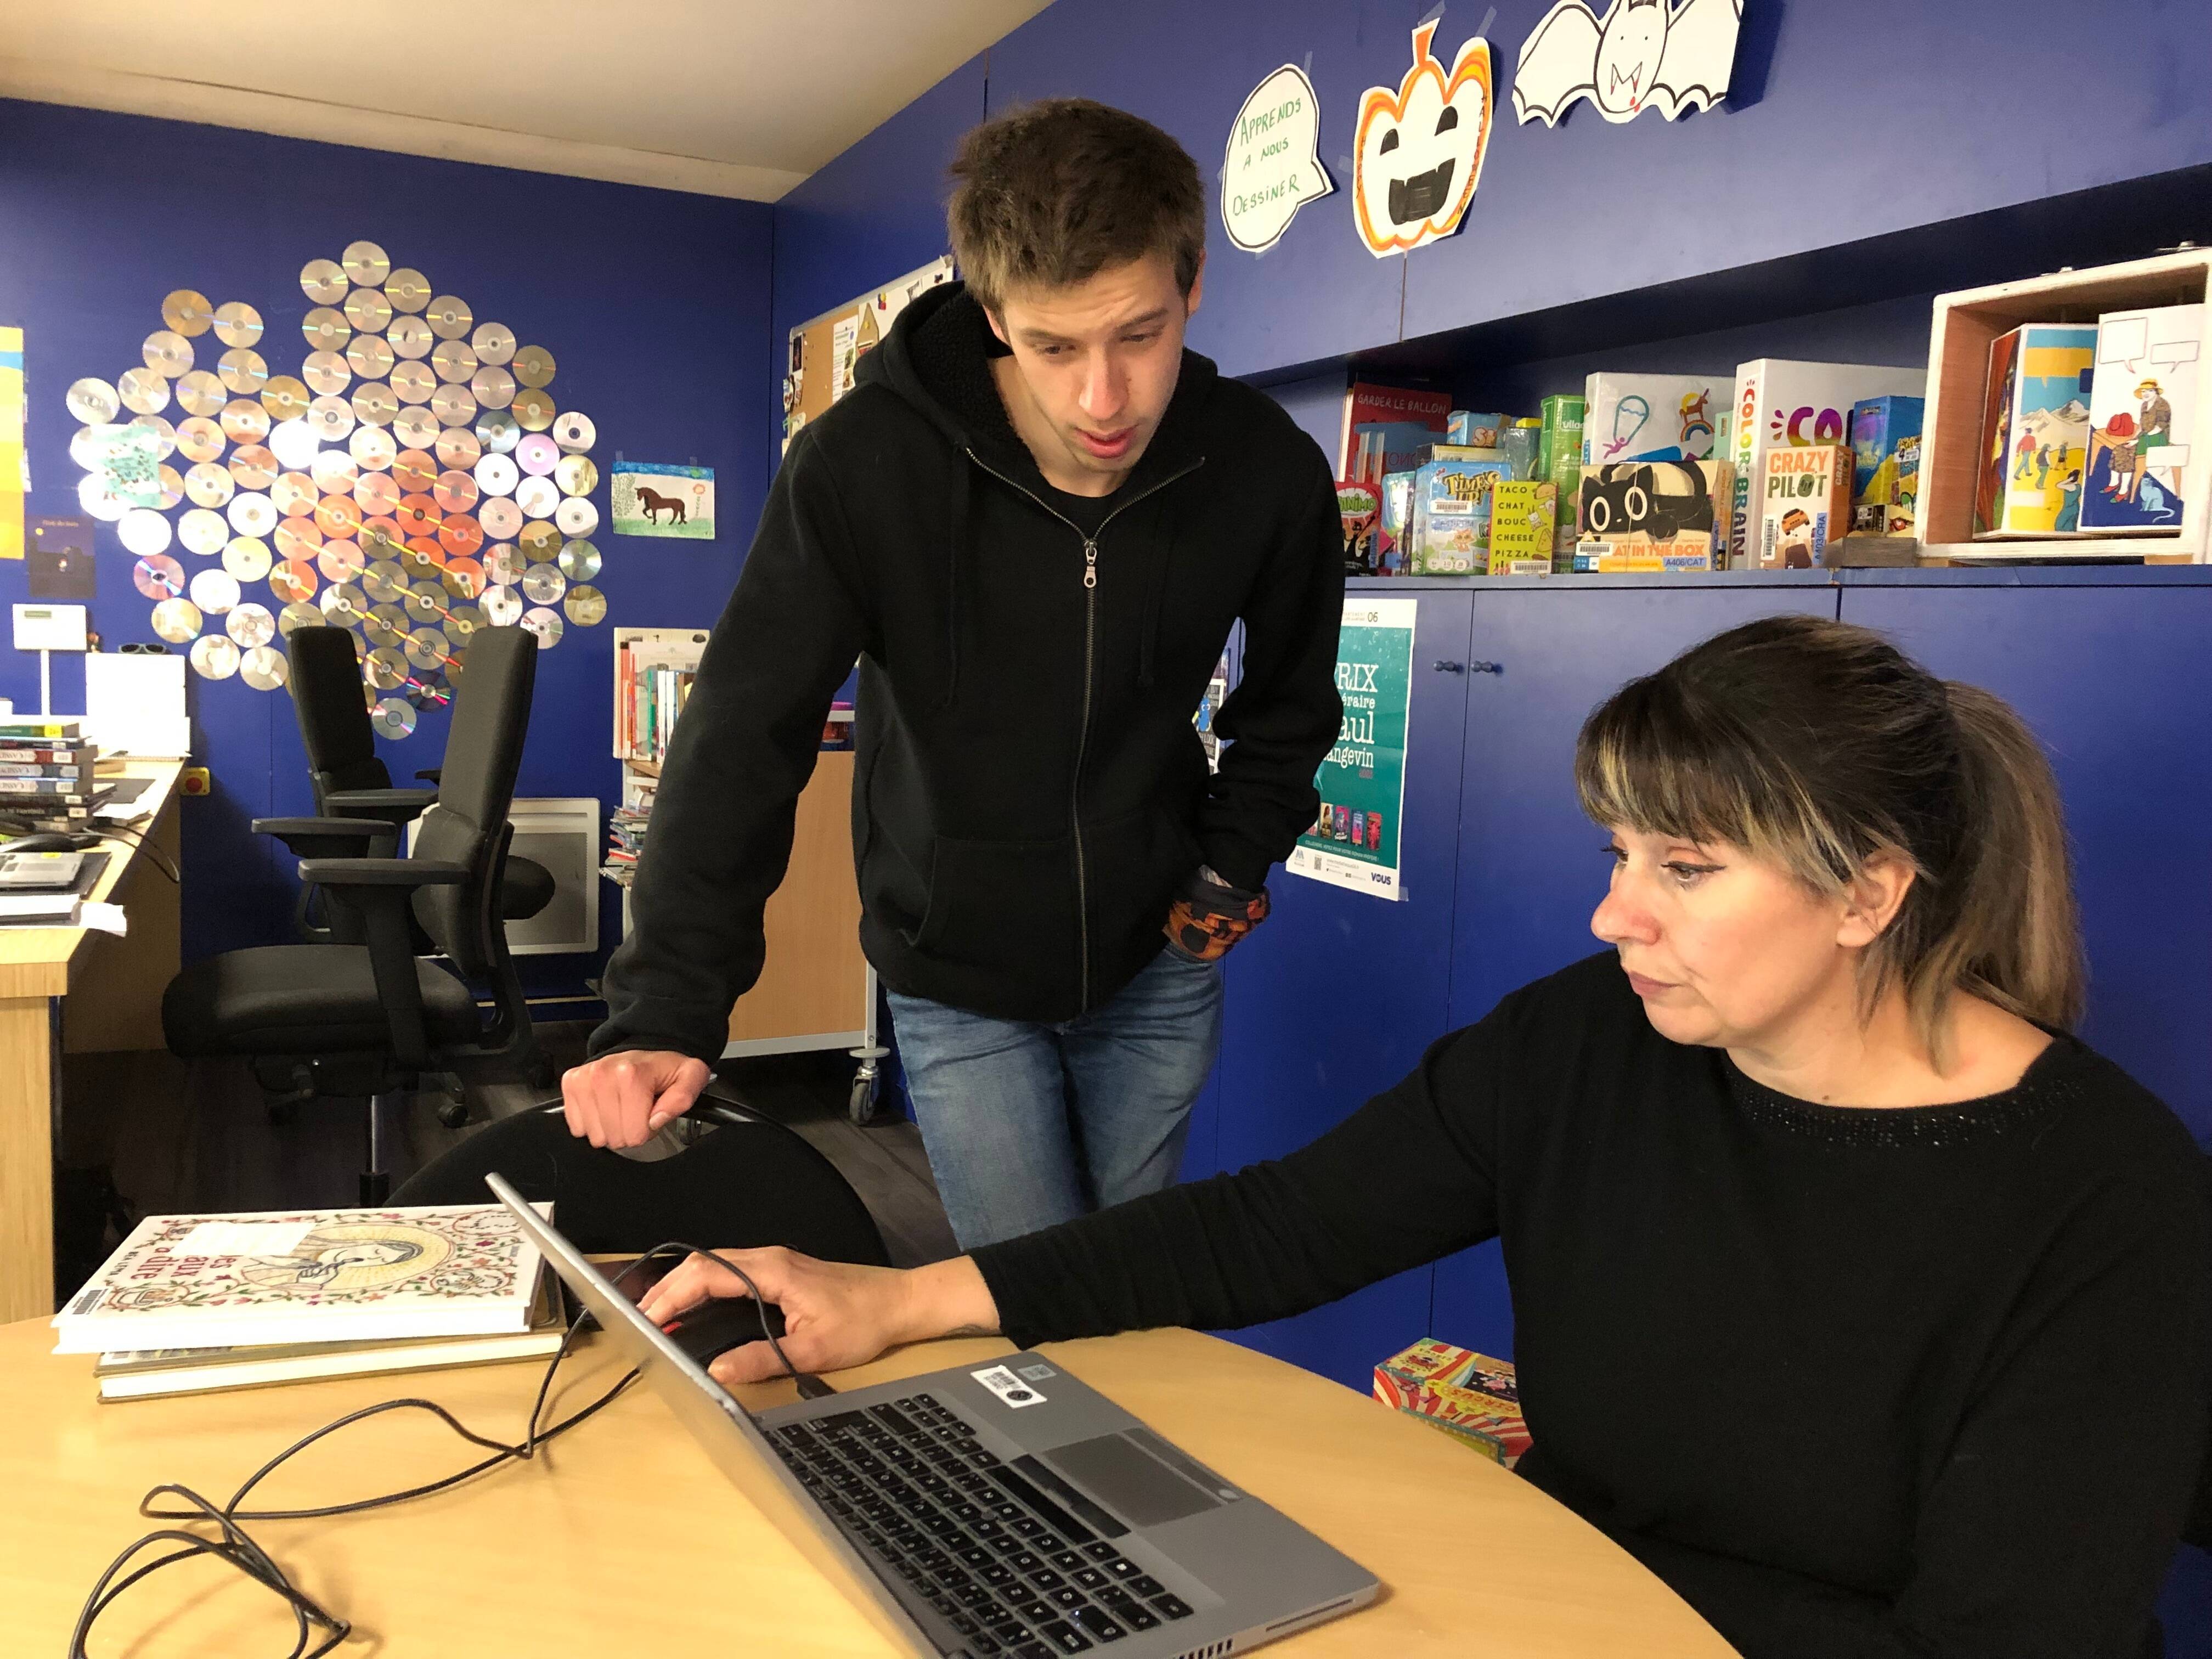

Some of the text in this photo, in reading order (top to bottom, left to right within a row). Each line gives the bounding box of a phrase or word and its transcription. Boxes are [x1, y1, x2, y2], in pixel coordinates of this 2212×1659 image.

[1240, 98, 1301, 146] APPRENDS
[1243, 137, 1289, 171] A NOUS
[1358, 393, 1446, 414] GARDER LE BALLON
[1770, 451, 1830, 474] CRAZY
[1899, 448, 1905, 460] 4
[1731, 388, 1755, 556] COLOR BRAIN
[1835, 450, 1843, 486] CRAZY
[1767, 473, 1827, 499] PILOT
[1612, 544, 1630, 556] AT
[1632, 544, 1645, 556] IN
[1647, 544, 1673, 556] THE
[1675, 544, 1705, 556] BOX
[1815, 515, 1826, 564] A403/CRA
[1666, 558, 1704, 566] A406/CAT
[1368, 612, 1378, 622] 06
[1336, 662, 1379, 693] RIX
[1342, 693, 1375, 709] éraire
[1338, 711, 1374, 744] aul
[1323, 746, 1374, 769] angevin
[1371, 872, 1391, 885] VOUS
[130, 1256, 180, 1280] dire
[171, 1255, 210, 1278] aux
[1454, 1389, 1516, 1412] CIRCUS
